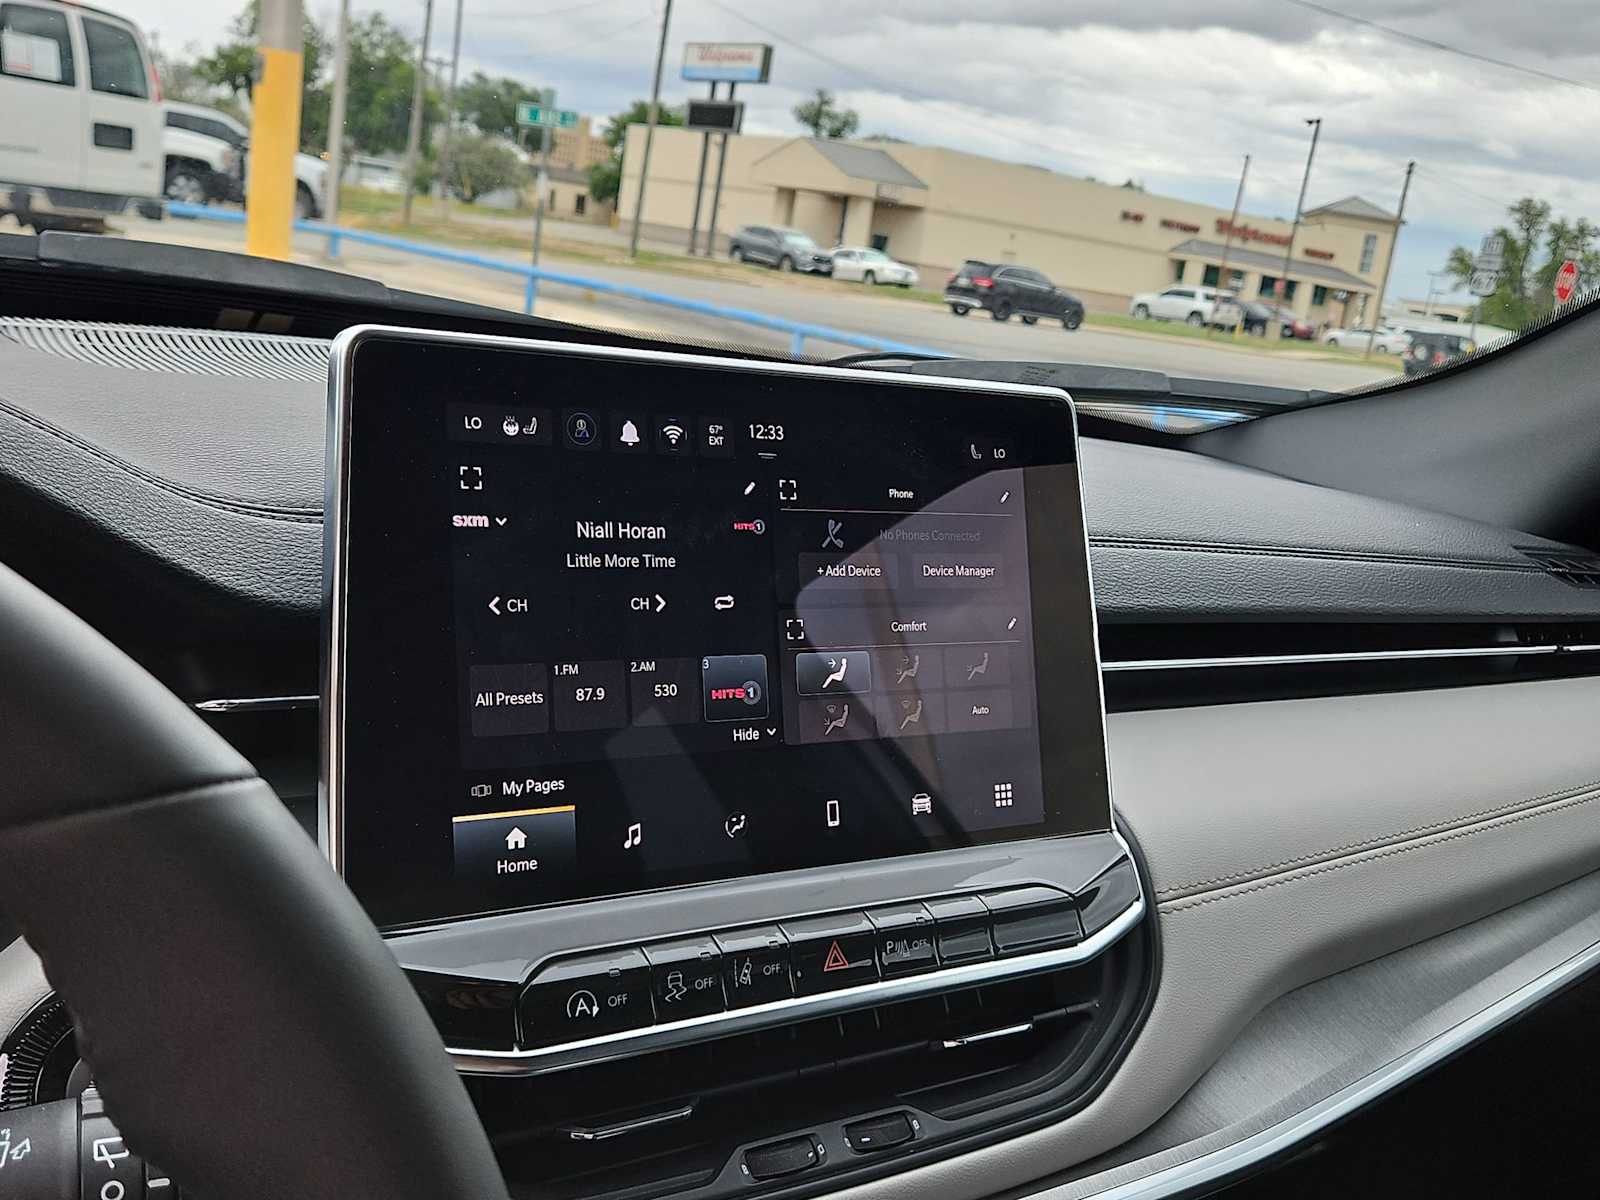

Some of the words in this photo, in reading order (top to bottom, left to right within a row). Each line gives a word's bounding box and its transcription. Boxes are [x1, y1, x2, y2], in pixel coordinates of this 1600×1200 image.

[464, 416, 482, 430] LO
[749, 424, 784, 441] 12:33
[708, 436, 724, 446] EXT
[993, 448, 1006, 459] LO
[888, 488, 914, 499] Phone
[452, 515, 489, 528] sxm
[576, 521, 613, 539] Niall
[618, 522, 666, 540] Horan
[879, 529, 893, 541] No
[895, 529, 930, 541] Phones
[931, 530, 981, 542] Connected
[566, 553, 601, 568] Little
[604, 554, 640, 568] More
[642, 554, 676, 568] Time
[825, 565, 846, 577] Add
[847, 565, 881, 577] Device
[923, 565, 954, 577] Device
[955, 566, 995, 579] Manager
[507, 599, 528, 612] CH
[630, 597, 649, 610] CH
[891, 620, 927, 632] Comfort
[554, 664, 579, 676] 1.FM
[630, 661, 656, 673] 2.AM
[575, 687, 605, 701] 87.9
[654, 684, 678, 697] 530
[475, 692, 493, 707] All
[496, 691, 544, 706] Presets
[971, 705, 989, 715] Auto
[733, 727, 760, 742] Hide
[502, 781, 523, 797] My
[526, 778, 565, 795] Pages
[497, 858, 538, 874] Home
[763, 963, 781, 976] OFF
[694, 978, 714, 990] OFF
[607, 993, 628, 1008] OFF
